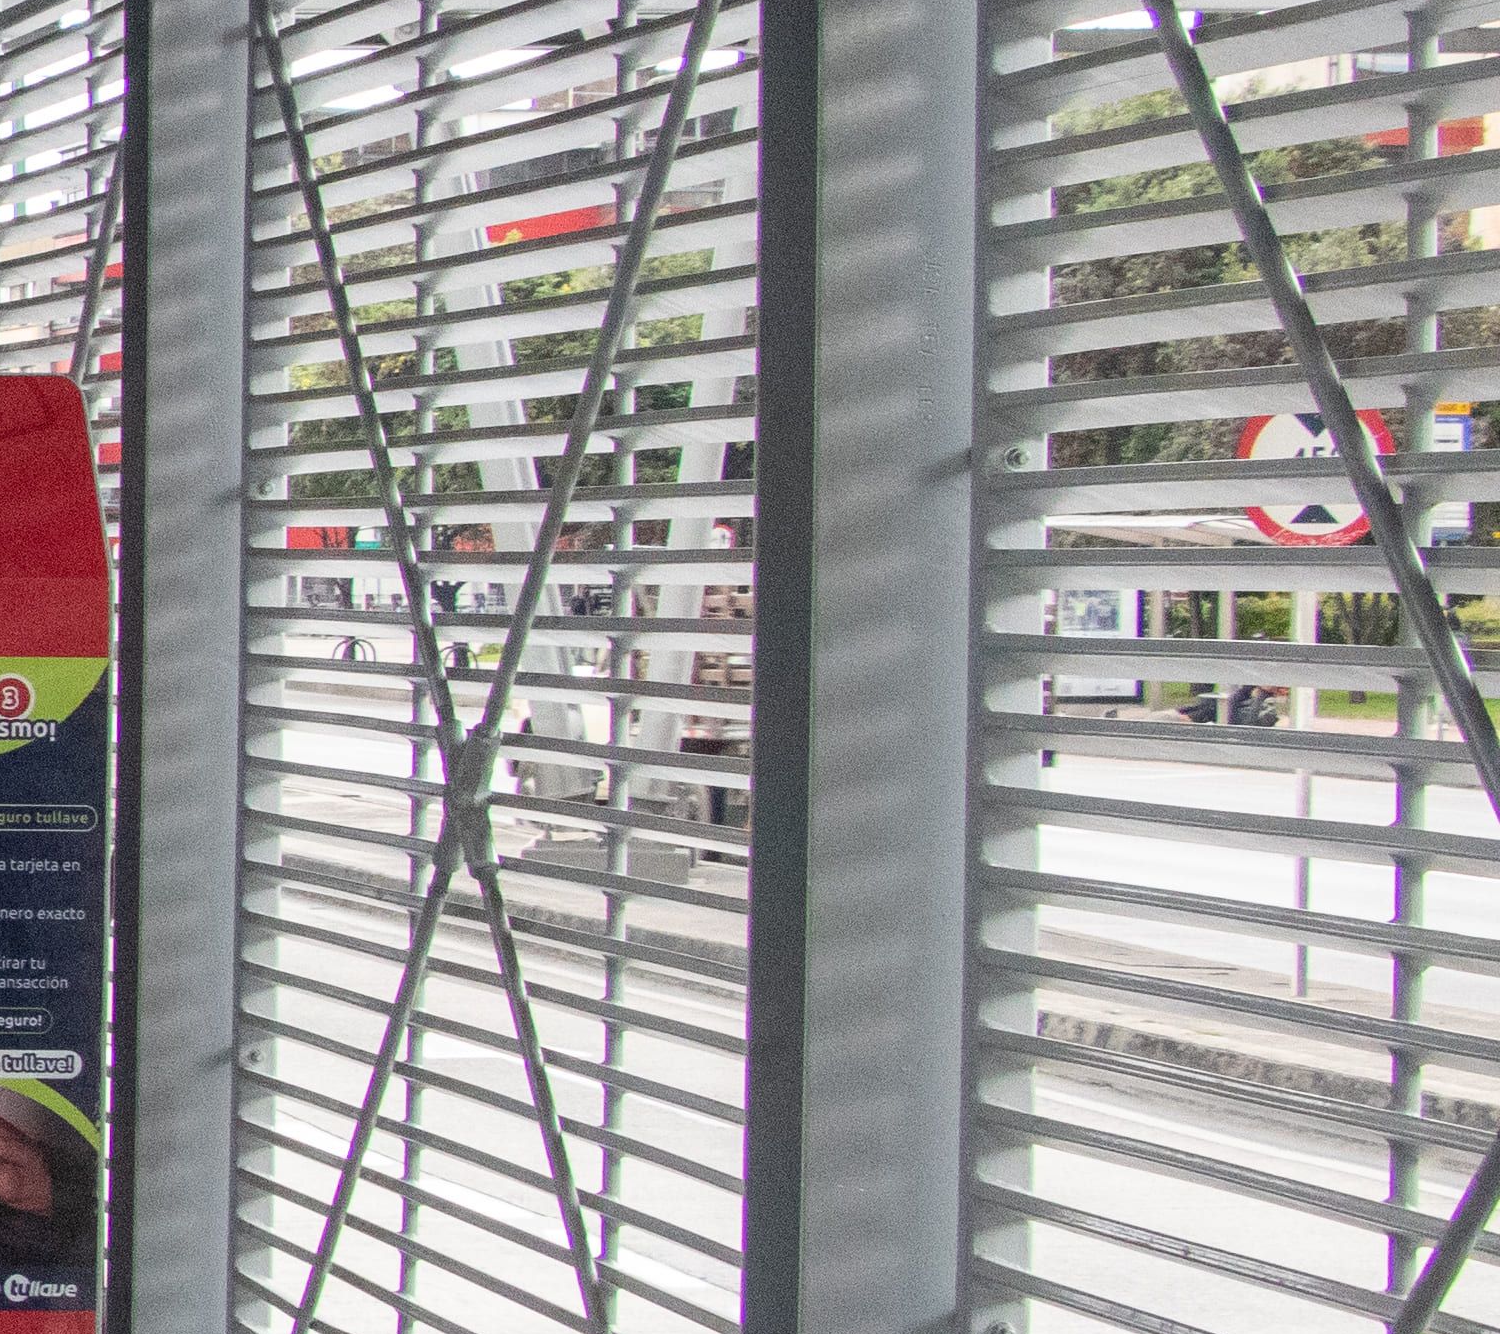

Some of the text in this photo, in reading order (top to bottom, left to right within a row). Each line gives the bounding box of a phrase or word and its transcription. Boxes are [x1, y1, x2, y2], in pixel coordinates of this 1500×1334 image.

[1, 685, 20, 710] 3
[36, 810, 91, 826] tullave
[10, 857, 59, 874] tarjeta
[62, 861, 81, 872] en
[37, 908, 86, 920] exacto
[30, 958, 46, 970] tu
[2, 1052, 75, 1074] tullave!
